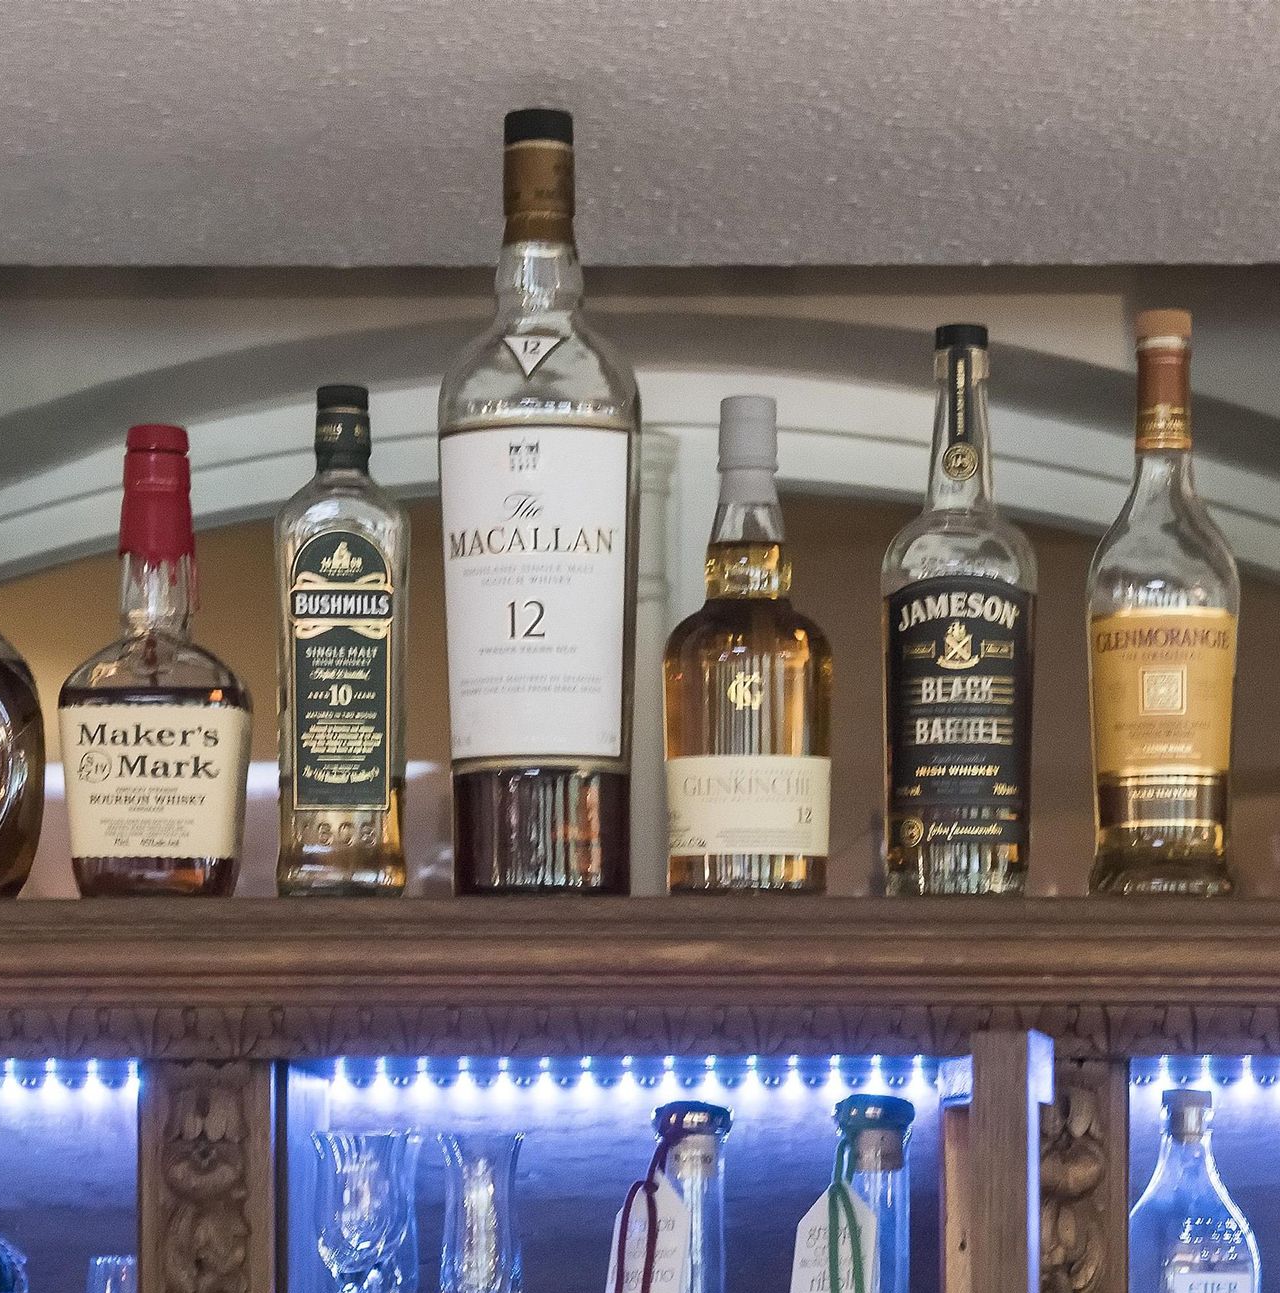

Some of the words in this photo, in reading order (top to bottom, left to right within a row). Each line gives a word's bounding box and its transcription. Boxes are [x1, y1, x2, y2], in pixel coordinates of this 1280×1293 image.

[522, 339, 541, 355] 12
[503, 492, 545, 522] The
[448, 527, 615, 560] MACALLAN
[294, 592, 390, 616] BUSHMILLS
[898, 591, 1019, 632] JAMESON
[506, 600, 547, 640] 12
[305, 647, 345, 659] SINGLE
[347, 646, 379, 658] MALT
[1096, 627, 1231, 653] GLENMORANGIE
[328, 684, 353, 706] 10
[920, 675, 995, 704] BLACK
[77, 721, 220, 748] Maker's
[116, 754, 222, 779] Mark
[915, 765, 947, 777] IRISH
[949, 764, 1000, 776] WHISKEY
[89, 794, 149, 806] BOURBON
[154, 794, 206, 806] WHISKY
[797, 806, 813, 825] 12
